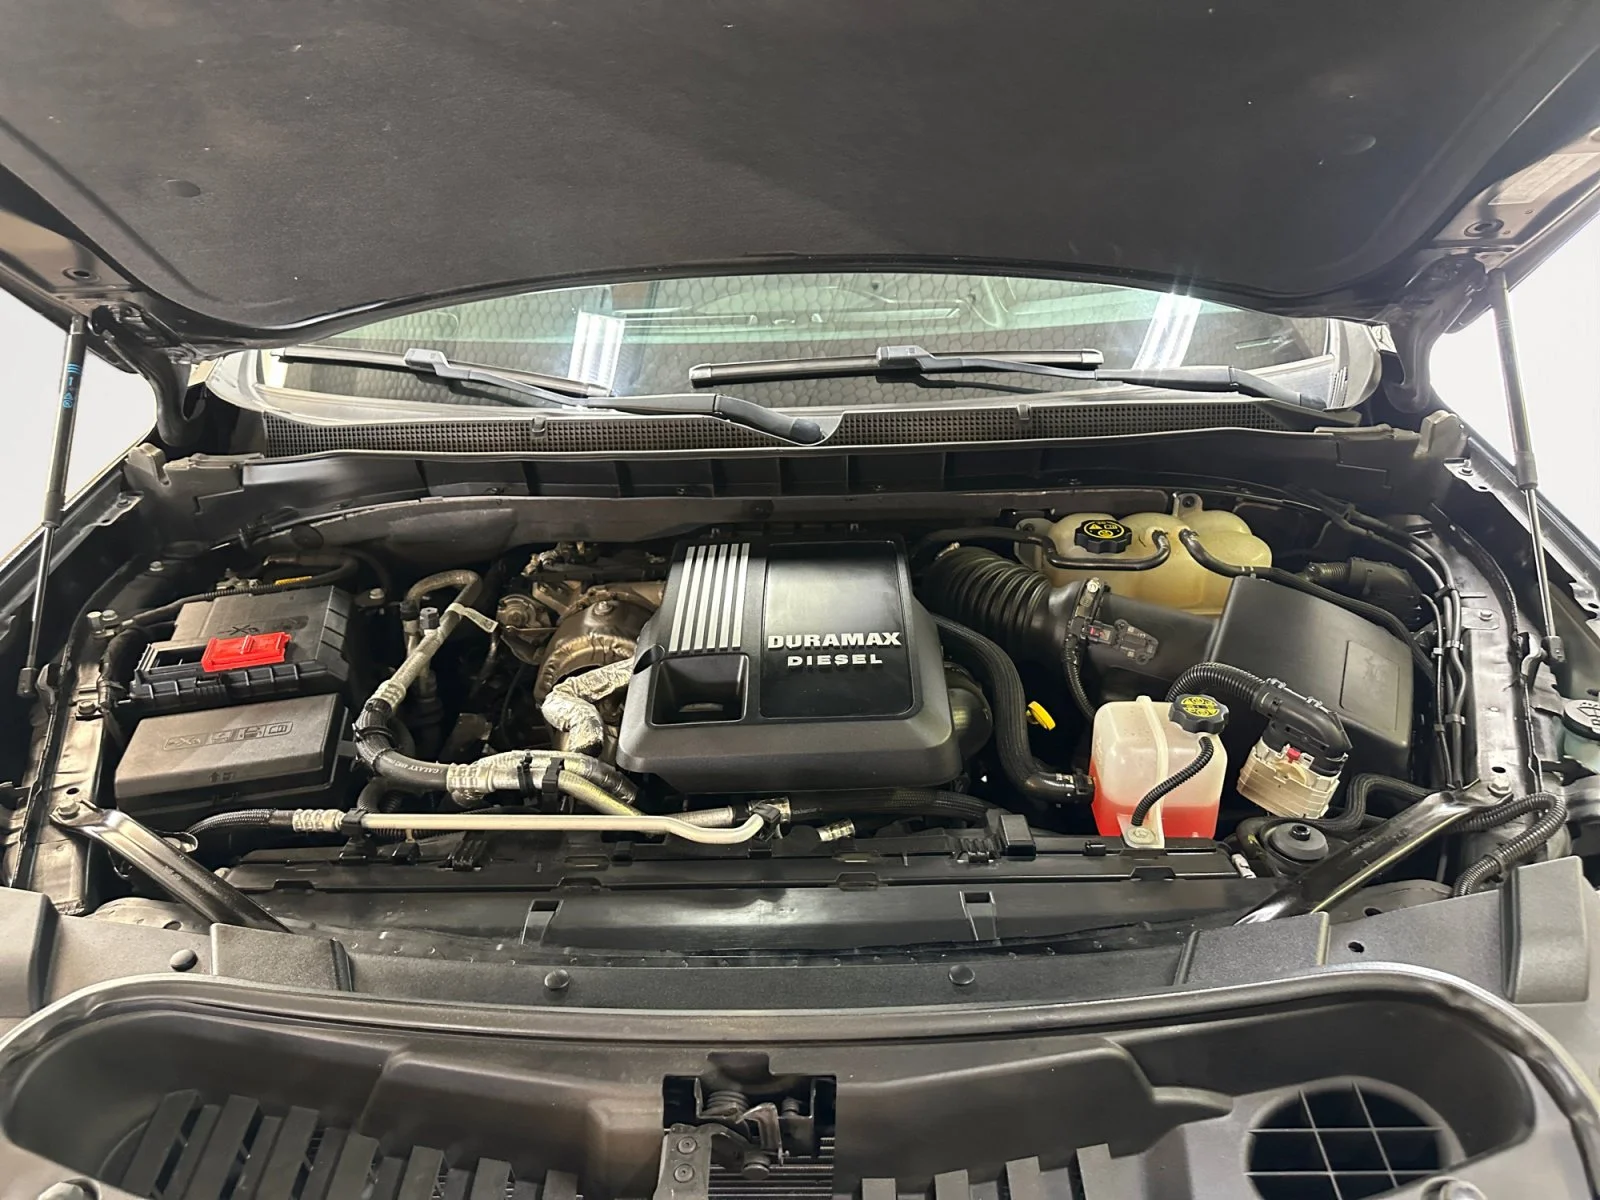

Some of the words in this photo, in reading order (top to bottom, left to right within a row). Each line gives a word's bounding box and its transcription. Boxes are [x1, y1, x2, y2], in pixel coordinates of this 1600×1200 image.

[767, 632, 902, 649] DURAMAX
[787, 653, 883, 667] DIESEL
[408, 764, 440, 774] GALAXY
